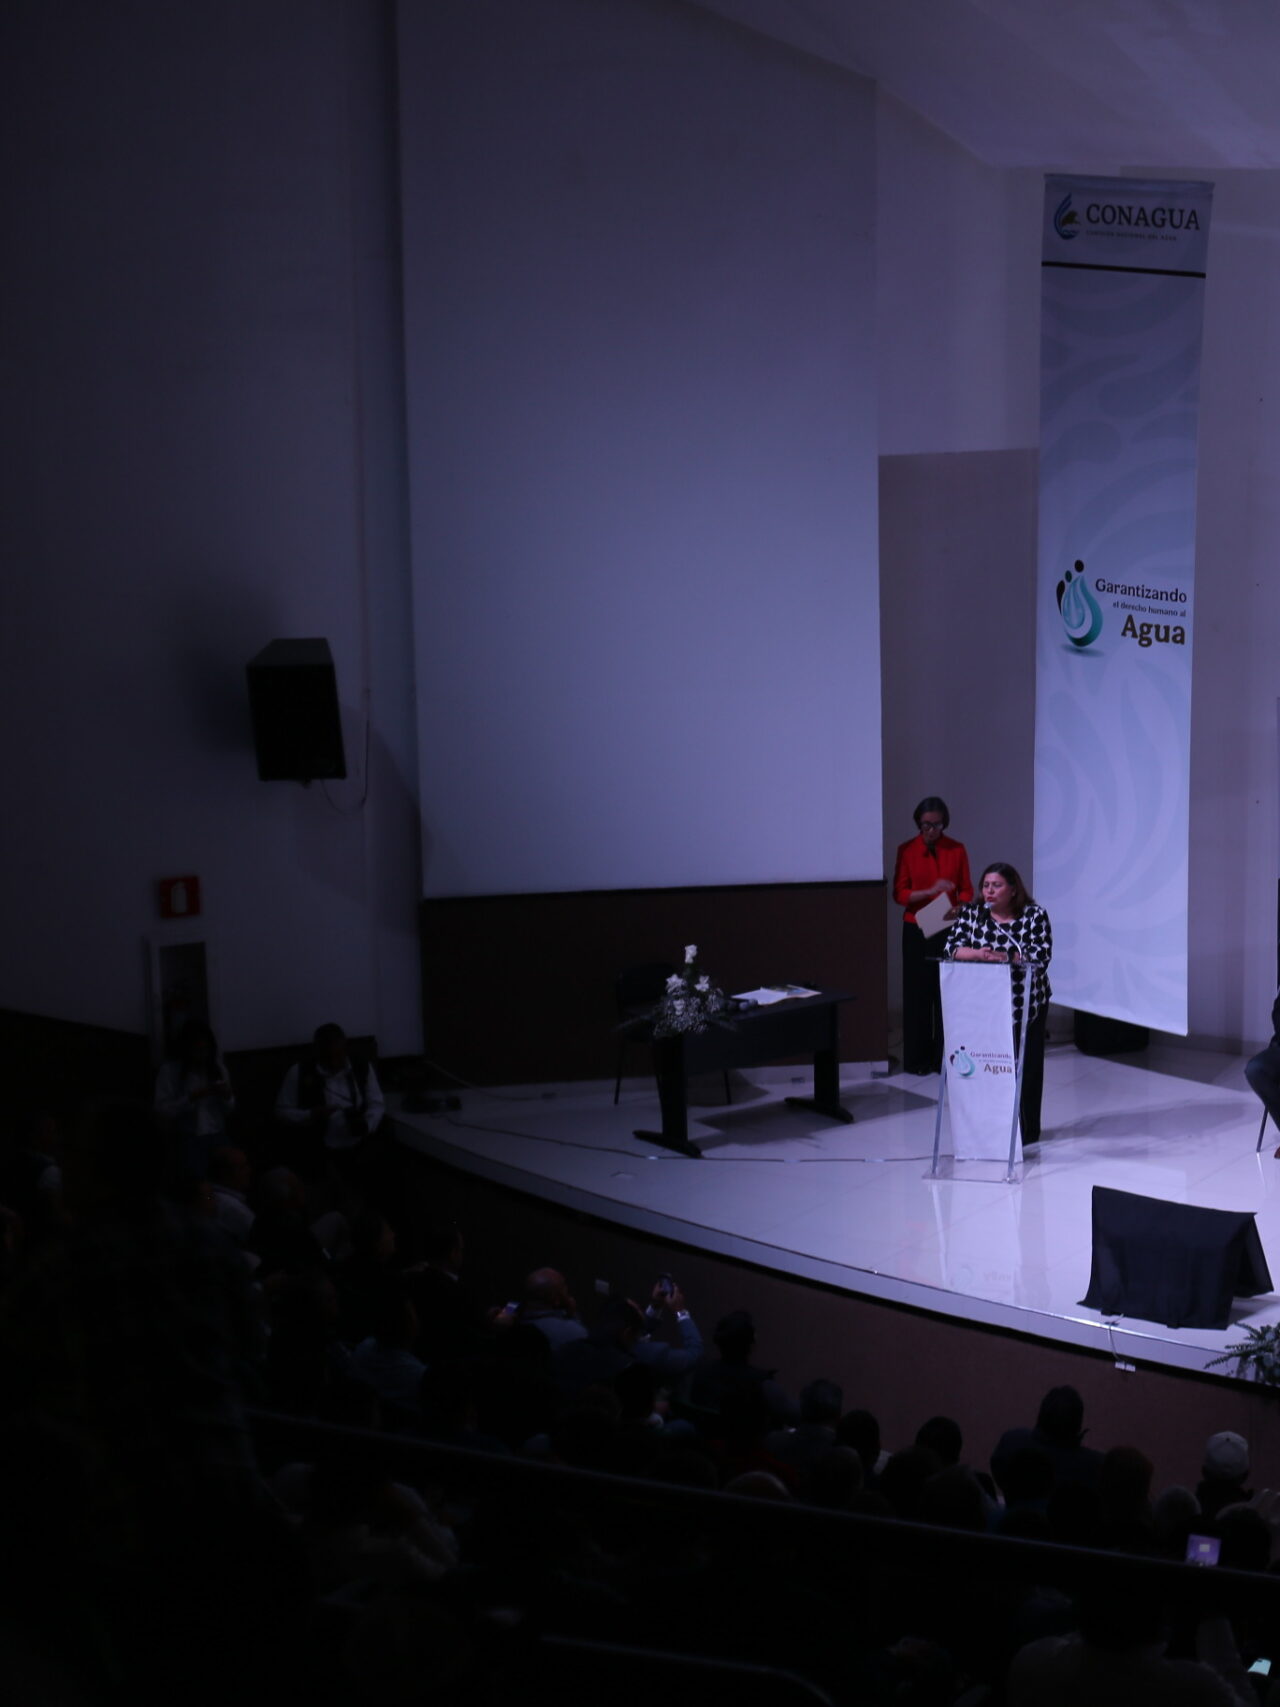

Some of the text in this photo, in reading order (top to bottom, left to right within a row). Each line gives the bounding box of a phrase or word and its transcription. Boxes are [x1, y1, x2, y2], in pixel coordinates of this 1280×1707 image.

[1086, 203, 1200, 231] CONAGUA
[1095, 578, 1187, 603] Garantizando
[1112, 601, 1119, 609] el
[1120, 602, 1147, 613] derecho
[1148, 605, 1178, 616] humano
[1121, 614, 1186, 648] Agua
[984, 1063, 1013, 1075] Agua
